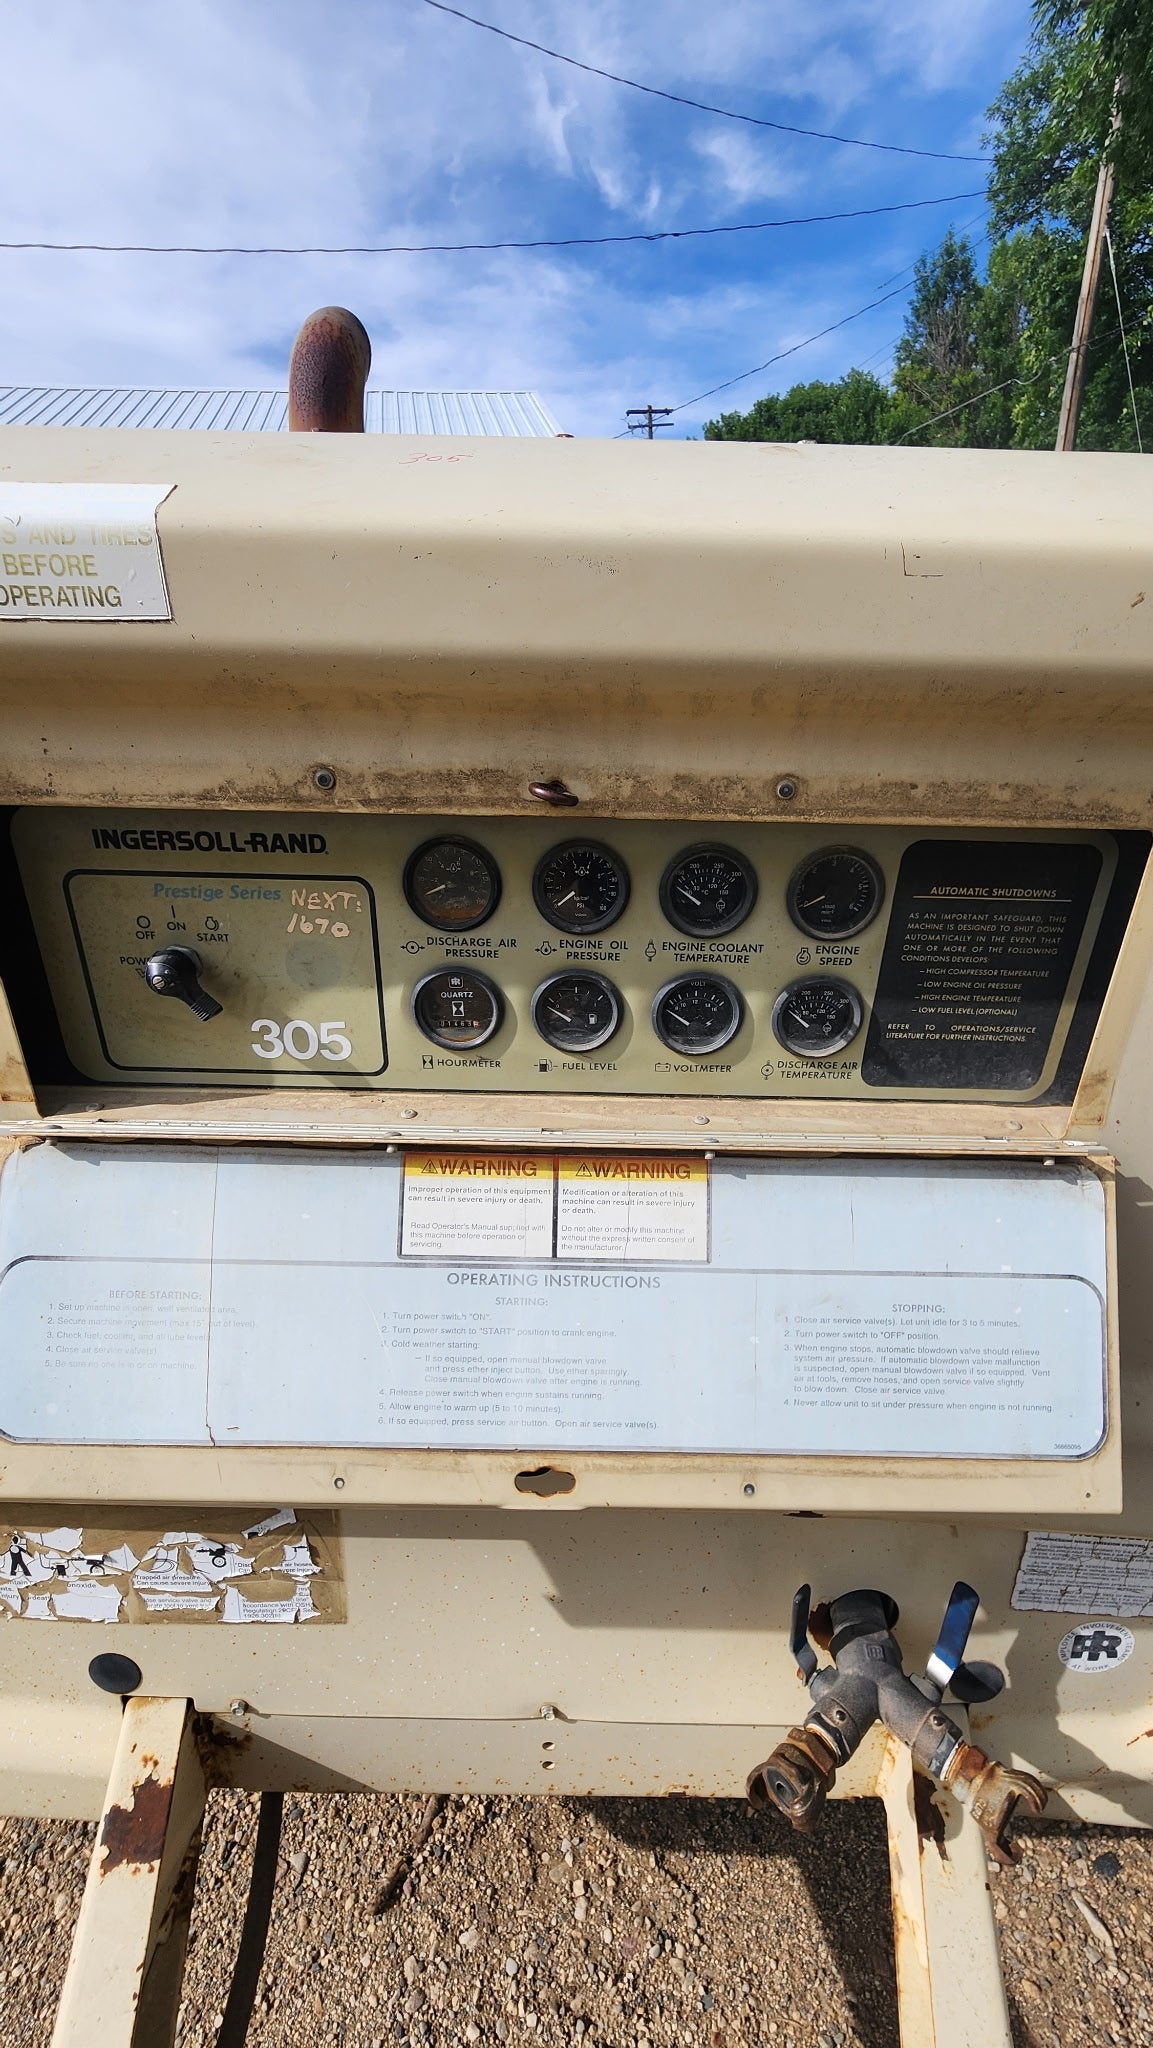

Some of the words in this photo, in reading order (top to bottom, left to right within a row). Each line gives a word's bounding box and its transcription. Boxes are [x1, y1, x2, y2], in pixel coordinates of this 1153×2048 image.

[399, 453, 473, 464] 305
[29, 525, 76, 545] AND
[88, 524, 153, 545] TIRES
[2, 553, 98, 577] BEFORE
[92, 828, 328, 855] INGERSOLL-RAND
[153, 883, 223, 902] Prestige
[230, 884, 282, 900] Series
[930, 886, 989, 896] AUTOMATIC
[991, 888, 1057, 898] SHUTDOWNS
[291, 888, 362, 913] NEXT:
[941, 913, 989, 921] IMPORTANT
[993, 915, 1044, 923] SAFEGUARD,
[167, 921, 186, 931] ON
[957, 924, 997, 932] DESIGNED
[1014, 925, 1034, 933] SHUT
[136, 931, 156, 940] OFF
[196, 933, 229, 943] START
[905, 934, 971, 942] AUTOMATICALLY
[427, 937, 492, 946] DISCHARGE
[499, 939, 517, 947] AIR
[560, 939, 603, 949] ENGINE
[610, 940, 628, 949] OIL
[662, 942, 706, 951] ENGINE
[709, 943, 764, 953] COOLANT
[815, 945, 860, 955] ENGINE
[943, 945, 967, 953] MORE
[1008, 947, 1058, 955] FOLLOWING
[445, 949, 499, 958] PRESSURE
[567, 952, 620, 961] PRESSURE
[674, 953, 750, 963] TEMPERATURE
[819, 958, 852, 966] SPEED
[901, 955, 950, 963] CONDITIONS
[951, 956, 990, 964] DEVELOPS:
[1000, 969, 1049, 978] TEMPERATURE
[972, 995, 1022, 1003] TEMPERATURE
[975, 1008, 1018, 1016] (OPTIONAL)
[950, 1025, 1037, 1034] OPERATIONS/SERVICE
[251, 1018, 352, 1061] 305
[972, 1034, 1026, 1042] INSTRUCTIONS.
[437, 1059, 501, 1068] HOURMETER
[777, 1061, 838, 1069] DISCHARGE
[841, 1062, 858, 1070] AIR
[781, 1071, 852, 1079] TEMPERATURE
[438, 1159, 537, 1176] WARNING
[592, 1162, 691, 1180] WARNING
[447, 1273, 538, 1286] OPERATING
[545, 1274, 661, 1289] INSTRUCTIONS
[109, 1290, 146, 1299] BEFORE
[150, 1290, 202, 1300] STARTING:
[495, 1297, 548, 1306] STARTING:
[892, 1304, 946, 1313] STOPPING:
[562, 1329, 584, 1337] crank
[587, 1330, 616, 1338] engine.
[795, 1330, 813, 1338] Turn
